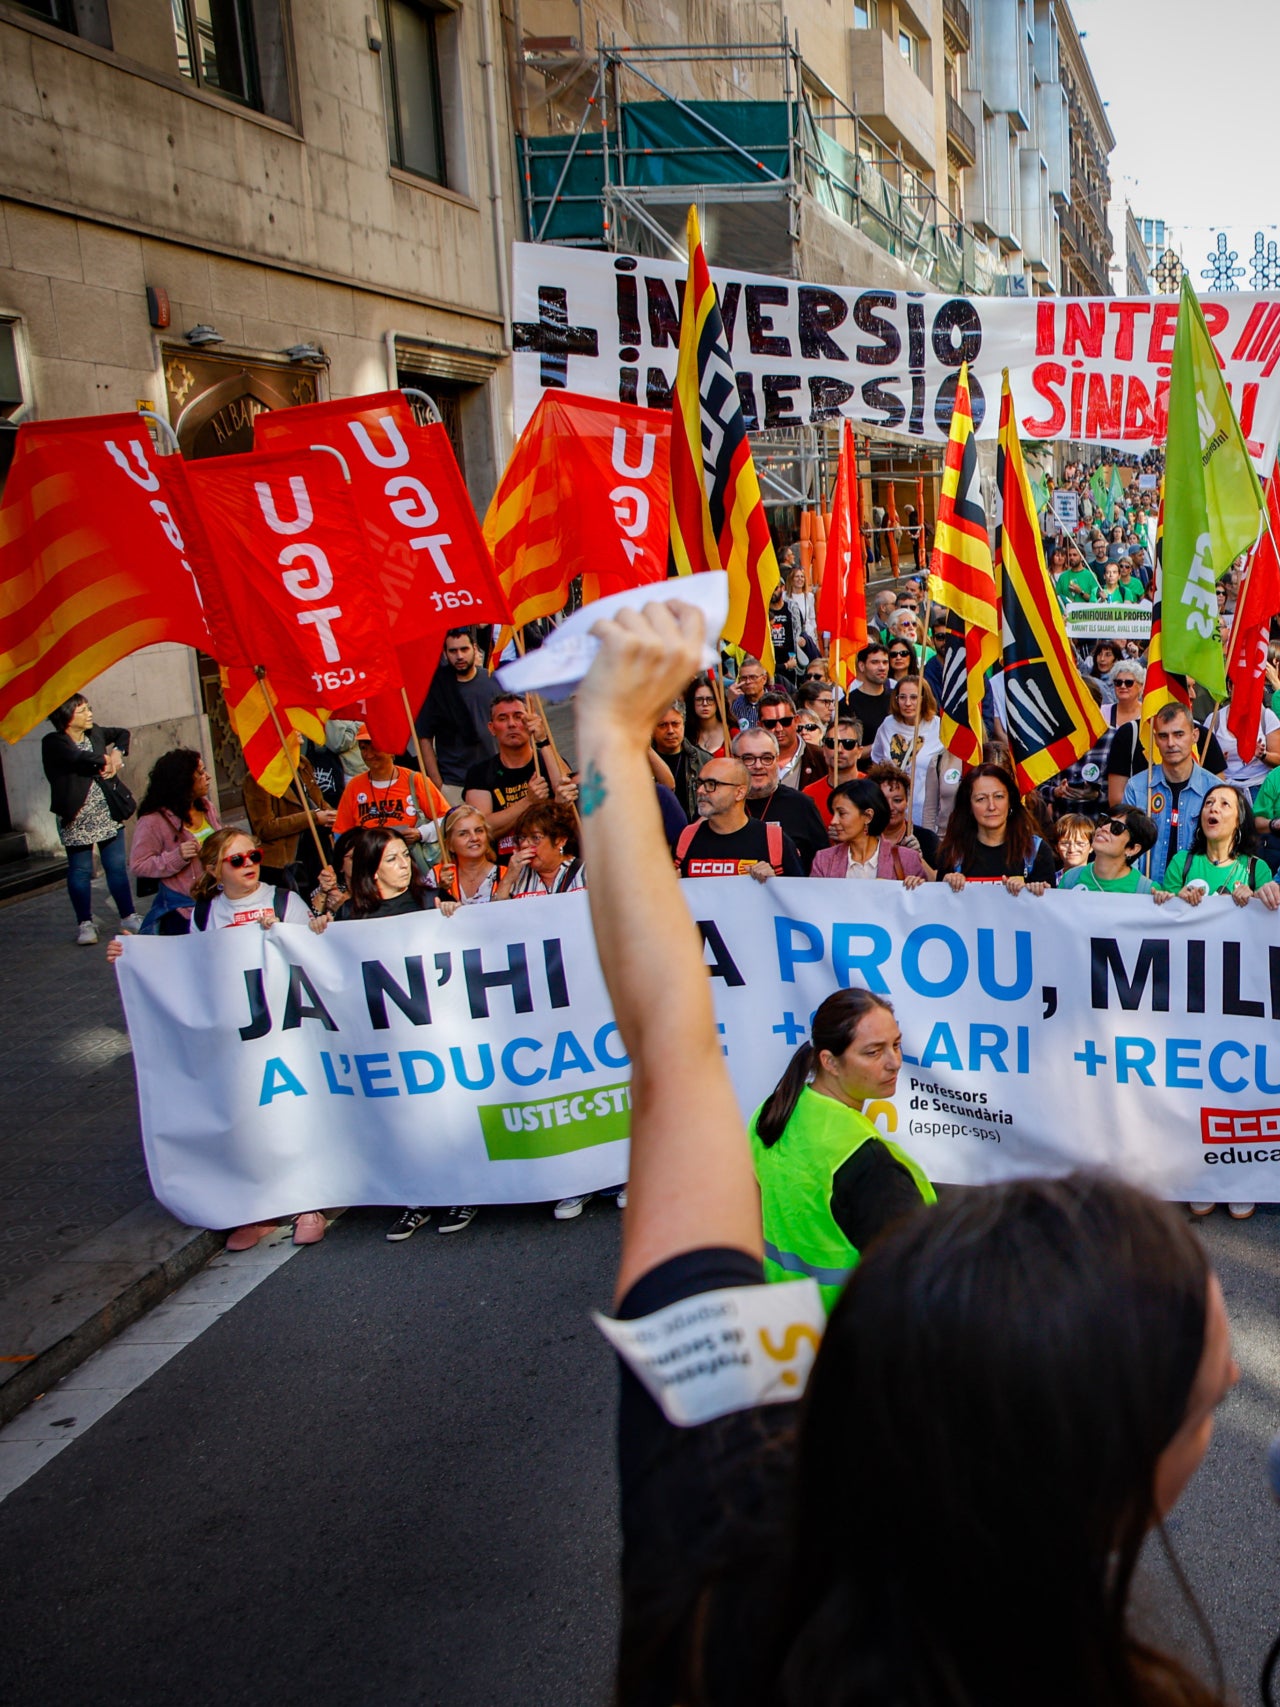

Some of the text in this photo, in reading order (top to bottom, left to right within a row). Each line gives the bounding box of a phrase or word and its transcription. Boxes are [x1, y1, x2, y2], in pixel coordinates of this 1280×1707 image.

[1071, 610, 1114, 621] DIGNIFIQUEM
[1114, 610, 1122, 620] LA
[691, 863, 734, 874] CCOO
[238, 964, 339, 1041] JA
[696, 919, 746, 987] A
[774, 916, 1058, 1020] PROU,
[259, 1056, 308, 1106] A
[910, 1076, 988, 1104] Professors
[909, 1096, 1013, 1126] de Secundària
